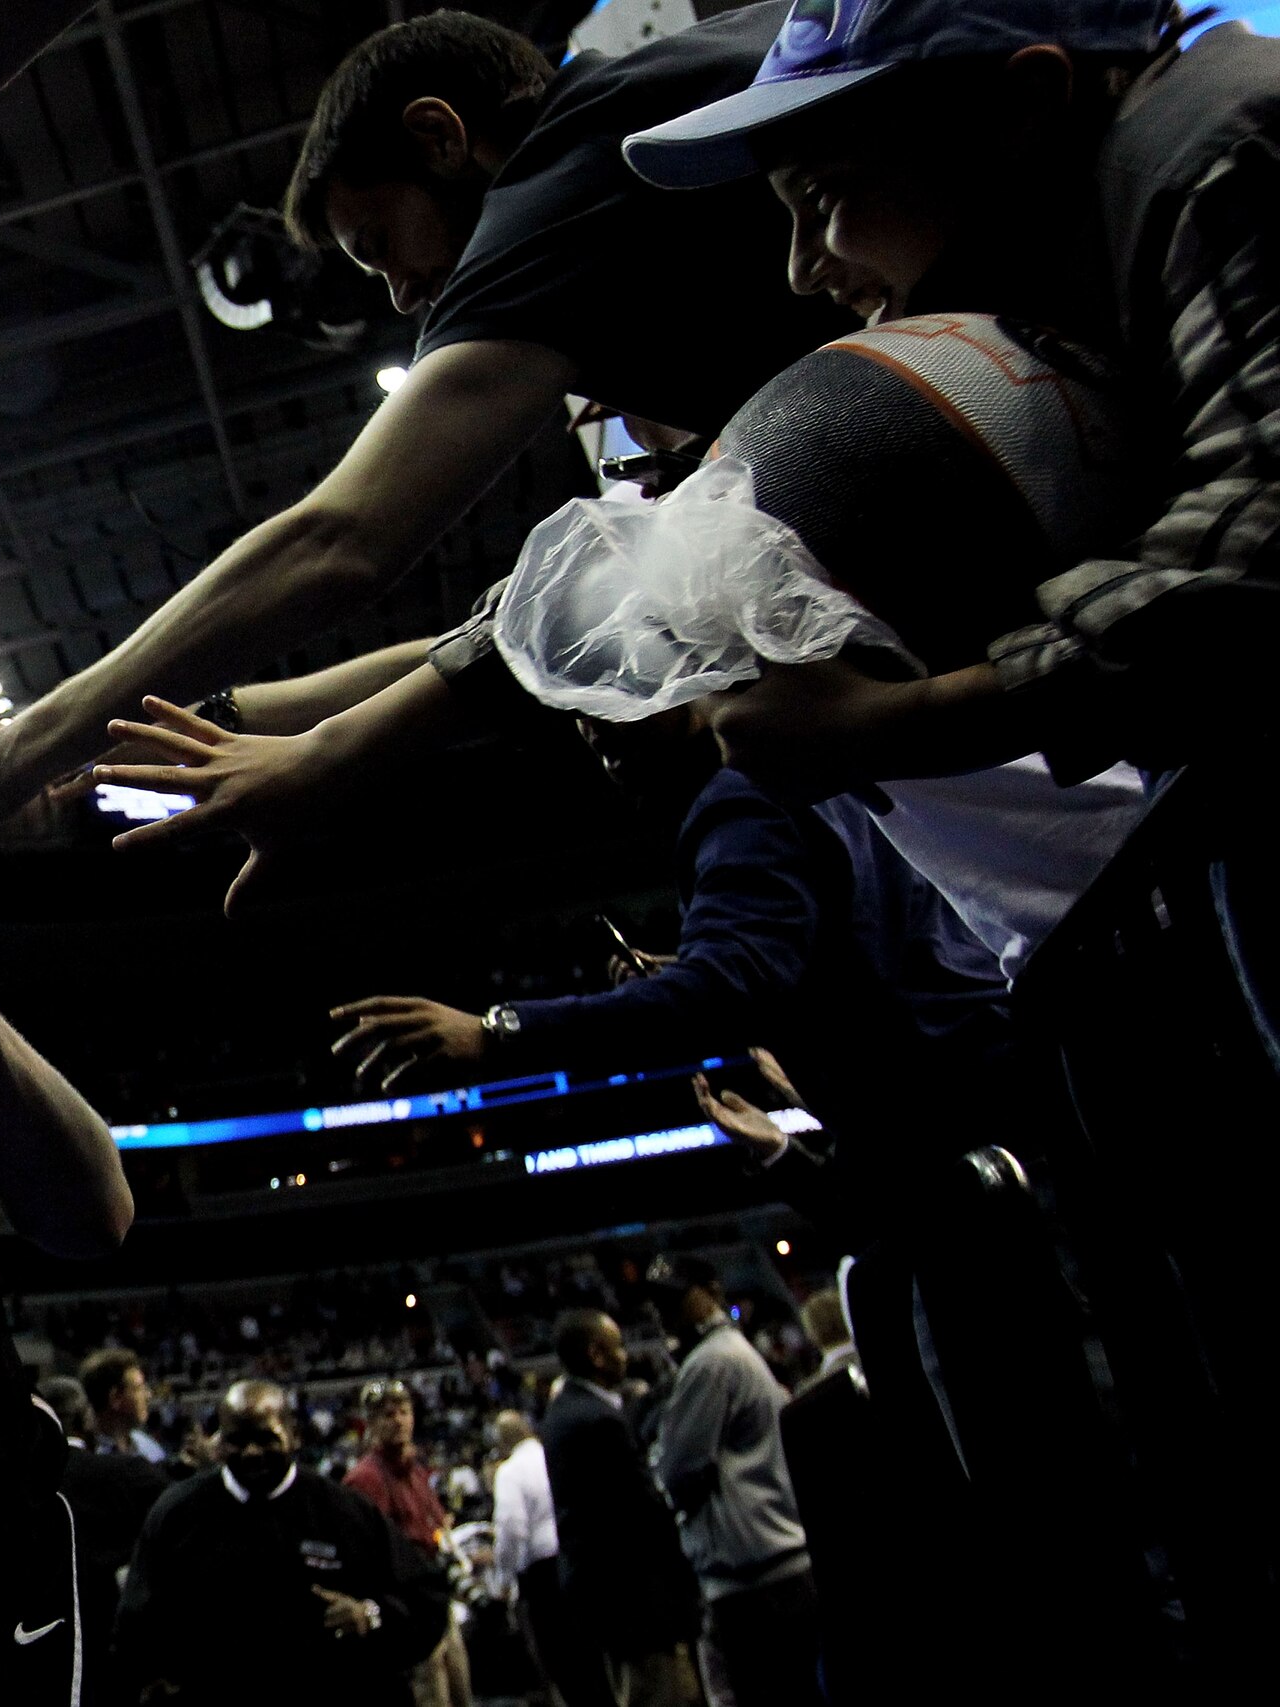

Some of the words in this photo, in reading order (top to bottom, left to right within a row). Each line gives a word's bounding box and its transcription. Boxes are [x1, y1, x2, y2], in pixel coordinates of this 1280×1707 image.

[536, 1148, 579, 1173] AND
[578, 1138, 636, 1166] THIRD
[634, 1125, 716, 1156] ROUNDS
